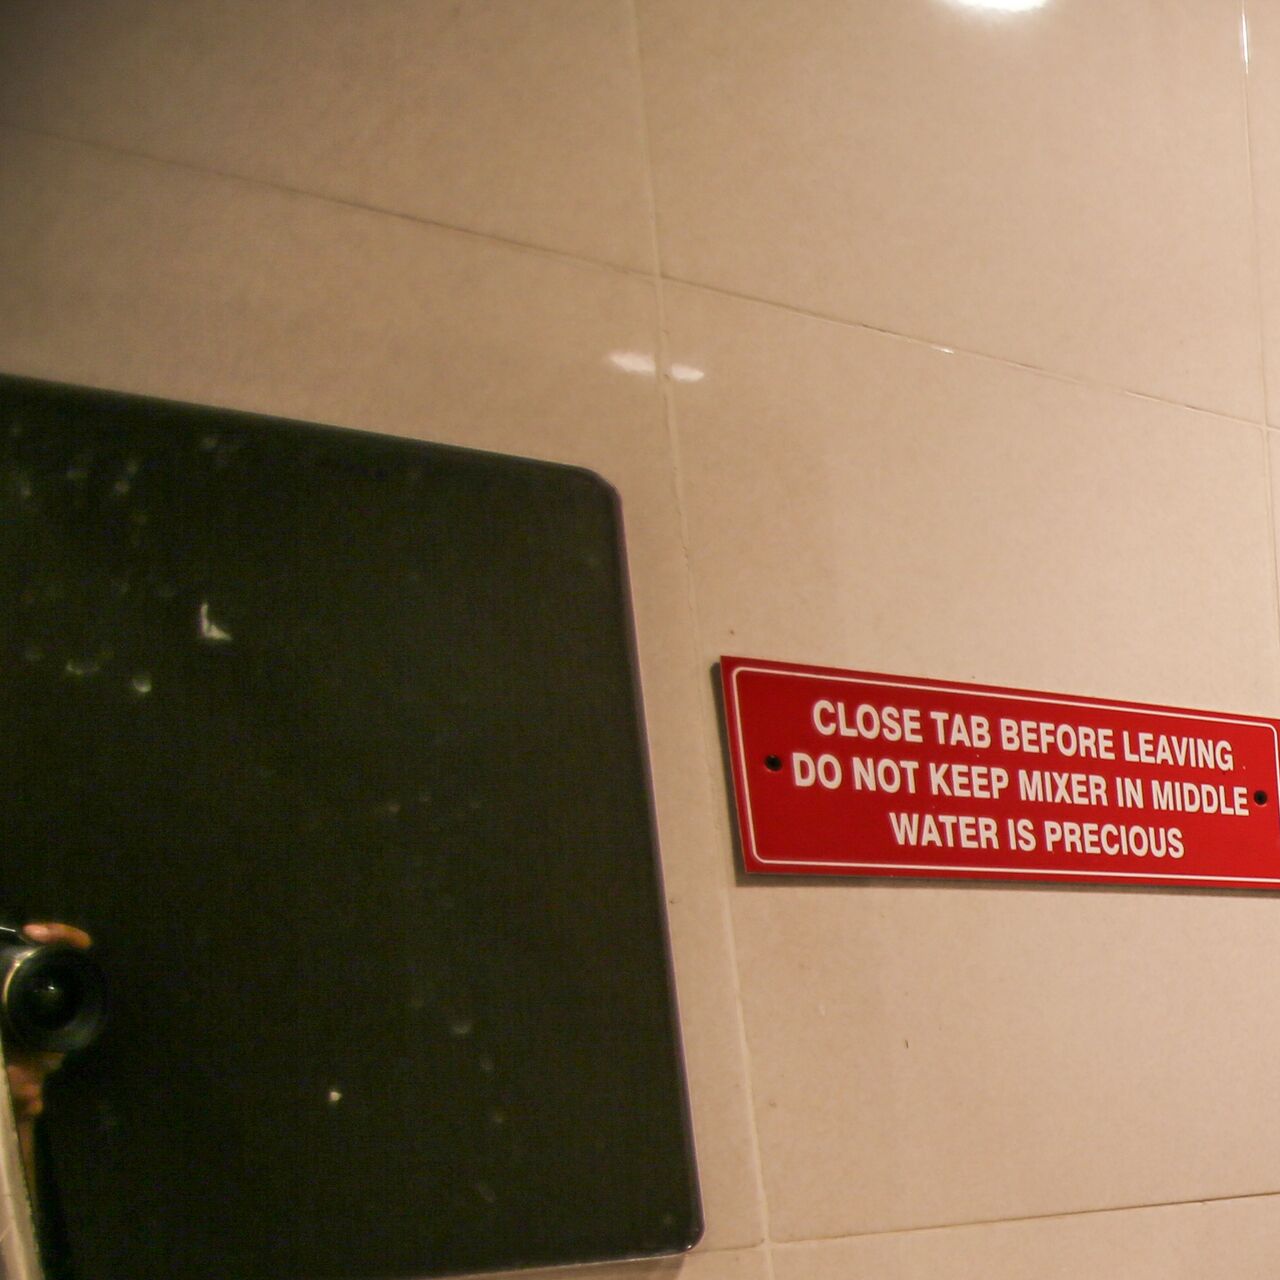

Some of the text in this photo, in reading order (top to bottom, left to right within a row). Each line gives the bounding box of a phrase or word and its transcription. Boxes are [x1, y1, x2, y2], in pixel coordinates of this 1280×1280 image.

[812, 699, 1235, 772] CLOSE TAB BEFORE LEAVING
[792, 752, 1250, 817] DO NOT KEEP MIXER IN MIDDLE
[889, 812, 1185, 859] WATER IS PRECIOUS
